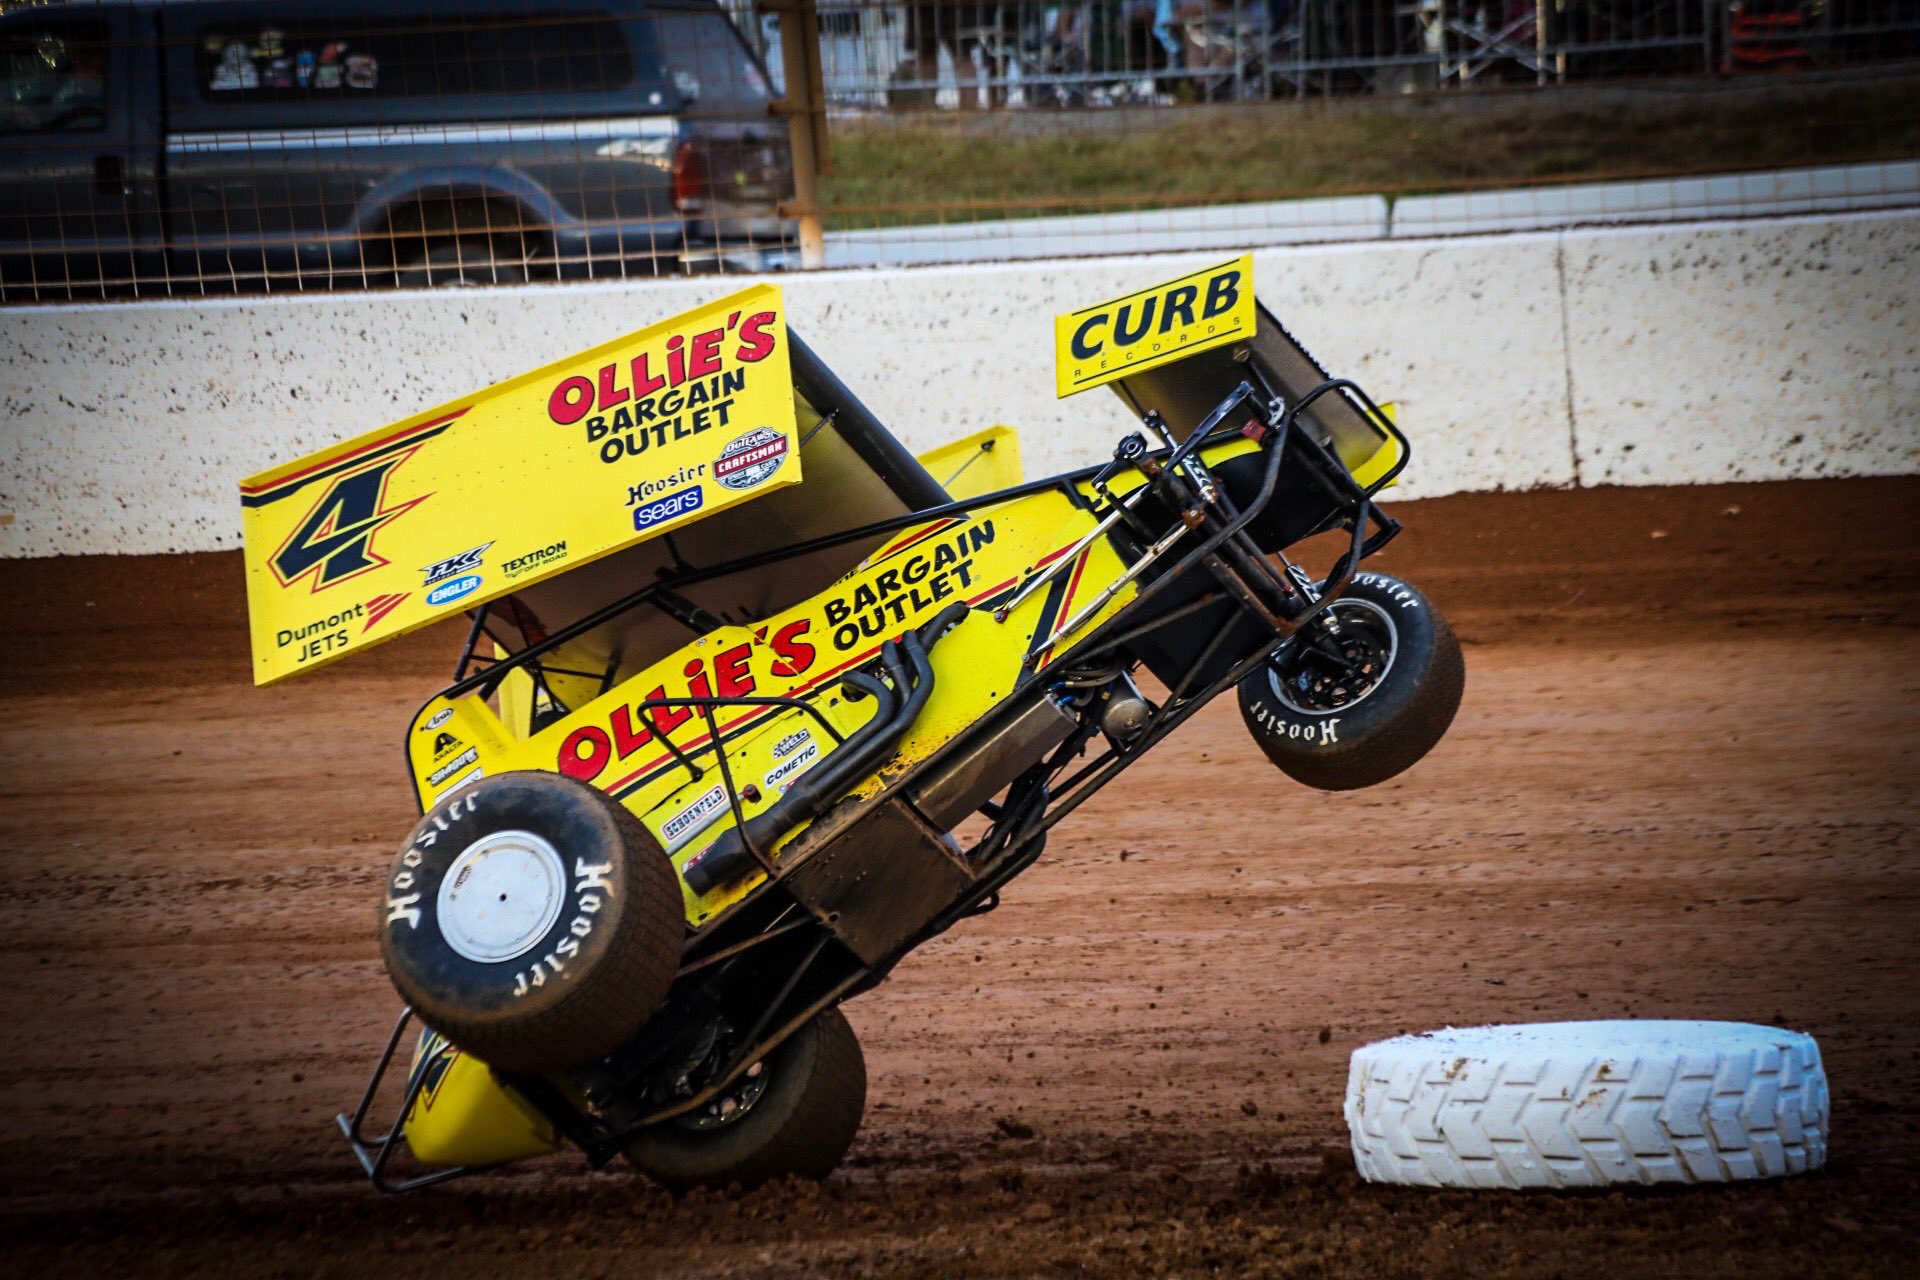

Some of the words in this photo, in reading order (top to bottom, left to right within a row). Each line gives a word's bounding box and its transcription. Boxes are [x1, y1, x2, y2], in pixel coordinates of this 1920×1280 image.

[1071, 270, 1241, 360] CURB
[1074, 317, 1240, 377] RECORDS
[585, 367, 745, 442] BARGAIN
[600, 398, 735, 464] OUTLET
[718, 441, 783, 473] CRAFTSMAN
[624, 464, 706, 507] Hoosier
[639, 491, 699, 524] sears
[268, 447, 416, 593] 4
[501, 540, 566, 573] TEXTRON
[524, 562, 540, 572] OFF
[543, 552, 567, 564] ROAD
[824, 519, 996, 628] BARGAIN
[431, 577, 477, 603] ENGLER
[832, 558, 973, 652] OUTLET
[276, 603, 363, 647] Dumont
[297, 629, 348, 663] JETS
[781, 730, 809, 754] WELD
[1249, 701, 1341, 746] Hoosier
[766, 745, 817, 785] COMETIC
[666, 789, 723, 837] SCHOENFELD
[387, 791, 479, 929] Hoosier
[513, 857, 616, 997] Hoosier
